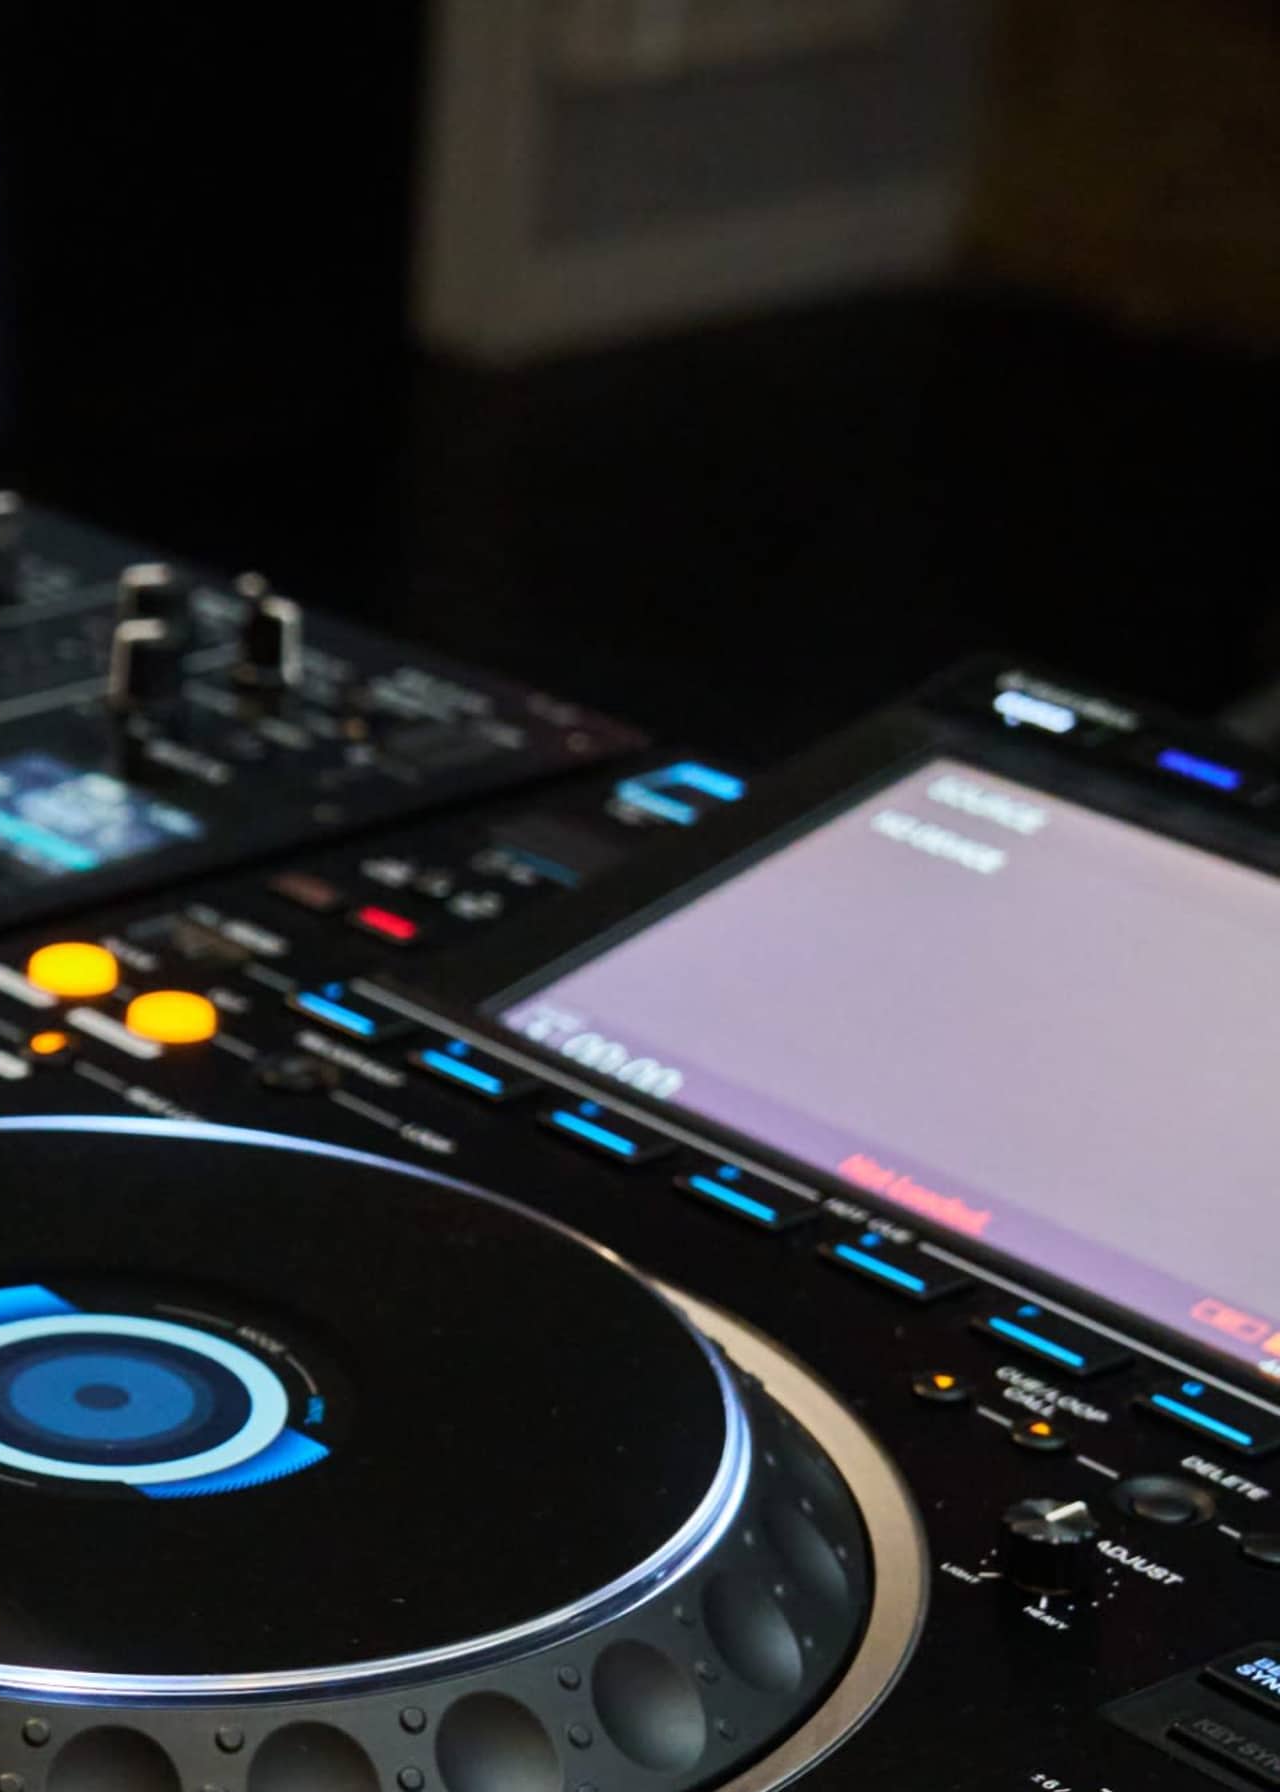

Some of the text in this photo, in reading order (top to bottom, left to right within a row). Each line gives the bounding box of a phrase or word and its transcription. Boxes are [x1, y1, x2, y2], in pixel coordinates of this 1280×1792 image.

[1181, 1455, 1271, 1501] DELETE
[1097, 1540, 1185, 1585] ADJUST
[1023, 1606, 1070, 1630] HEAVY
[1193, 1718, 1246, 1746] KEY
